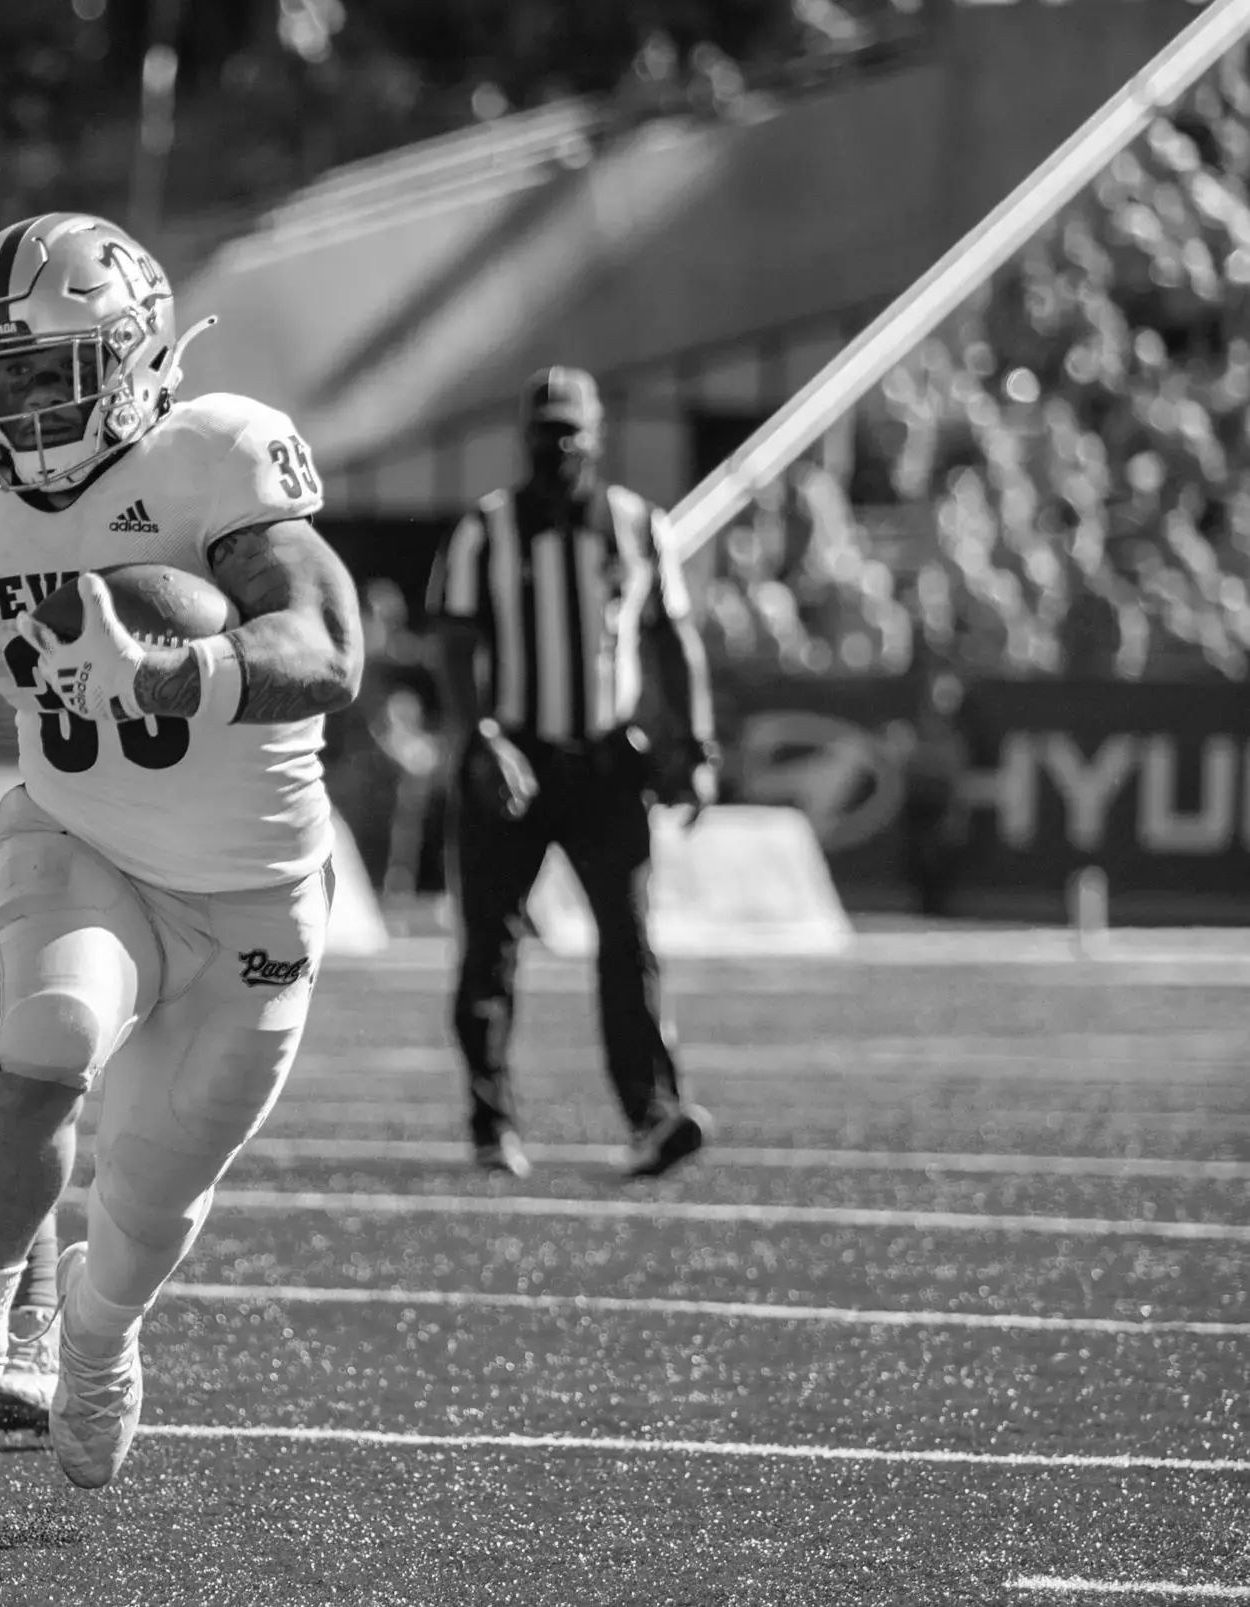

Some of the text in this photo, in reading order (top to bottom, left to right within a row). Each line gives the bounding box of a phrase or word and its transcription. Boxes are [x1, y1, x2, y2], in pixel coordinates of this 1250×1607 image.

[267, 435, 318, 500] 35
[109, 519, 159, 533] adidas
[945, 731, 1250, 852] HYU
[238, 949, 309, 988] Pack
